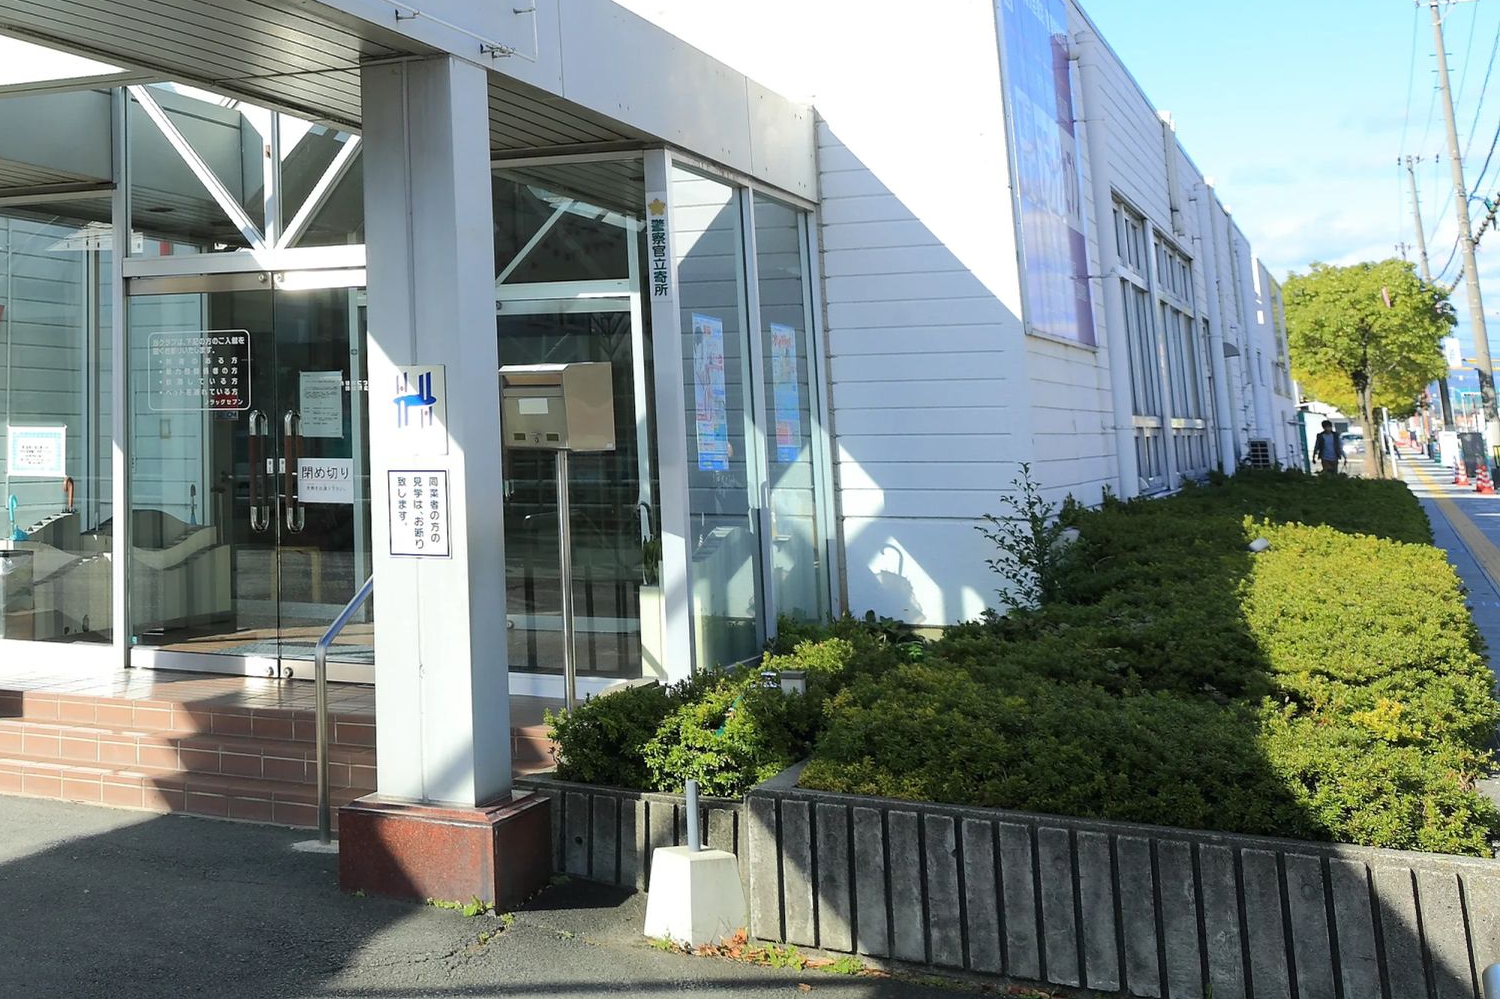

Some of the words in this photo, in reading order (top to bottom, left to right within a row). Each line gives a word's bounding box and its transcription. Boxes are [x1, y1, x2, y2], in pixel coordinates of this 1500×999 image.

[650, 218, 669, 297] 警察官立寄所
[301, 465, 349, 480] 閉め切り
[397, 476, 408, 527] 致します。
[413, 476, 425, 550] 見学は、お断り
[428, 476, 441, 544] 同業者の方の
